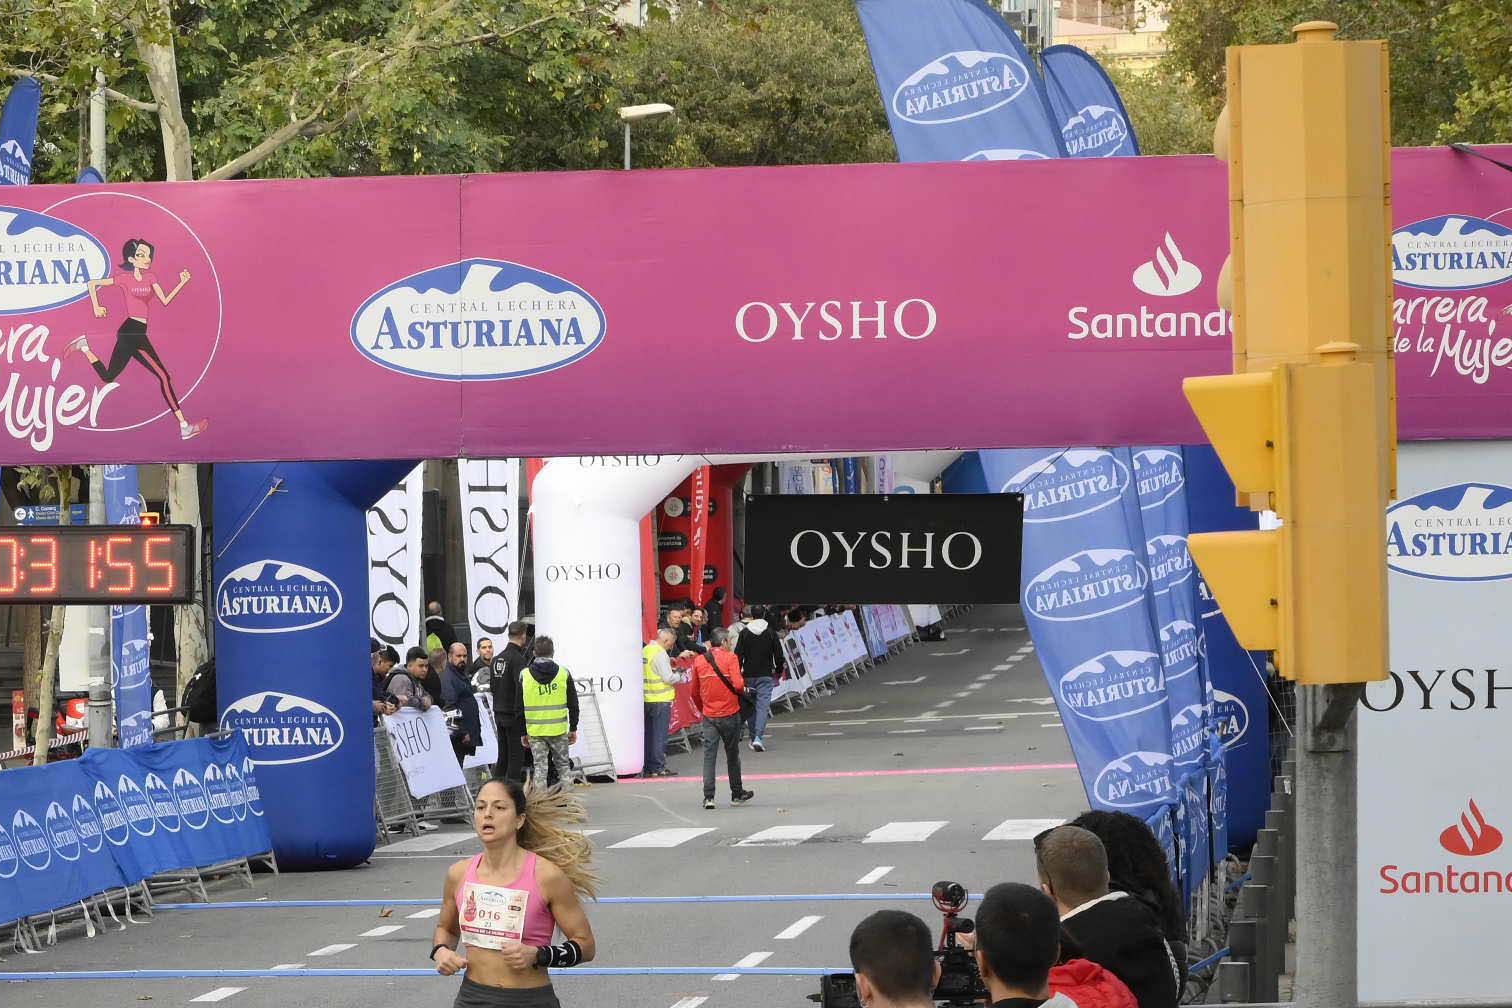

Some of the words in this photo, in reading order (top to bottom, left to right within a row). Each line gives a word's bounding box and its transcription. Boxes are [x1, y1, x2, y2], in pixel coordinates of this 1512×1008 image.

[14, 241, 86, 253] LECHERA
[1407, 239, 1458, 249] CENTRAL
[409, 301, 489, 314] CENTRAL
[496, 299, 578, 313] LECHERA
[1392, 295, 1488, 325] arrera
[370, 305, 587, 350] ASTURIANA
[734, 298, 938, 343] OYSHO
[1067, 304, 1234, 340] Santand
[1416, 325, 1436, 353] la
[1430, 319, 1512, 385] Muje
[1414, 517, 1481, 527] CENTRAL
[790, 529, 983, 570] OYSHO
[545, 562, 622, 583] OYSHO
[233, 585, 275, 594] CENTRAL
[279, 584, 329, 593] LECHERA
[220, 589, 334, 617] ASTURIANA
[576, 675, 623, 694] SHO
[1359, 668, 1512, 712] OYSH
[234, 717, 276, 725] CENTRAL
[280, 716, 330, 724] LECHERA
[479, 909, 501, 921] 016
